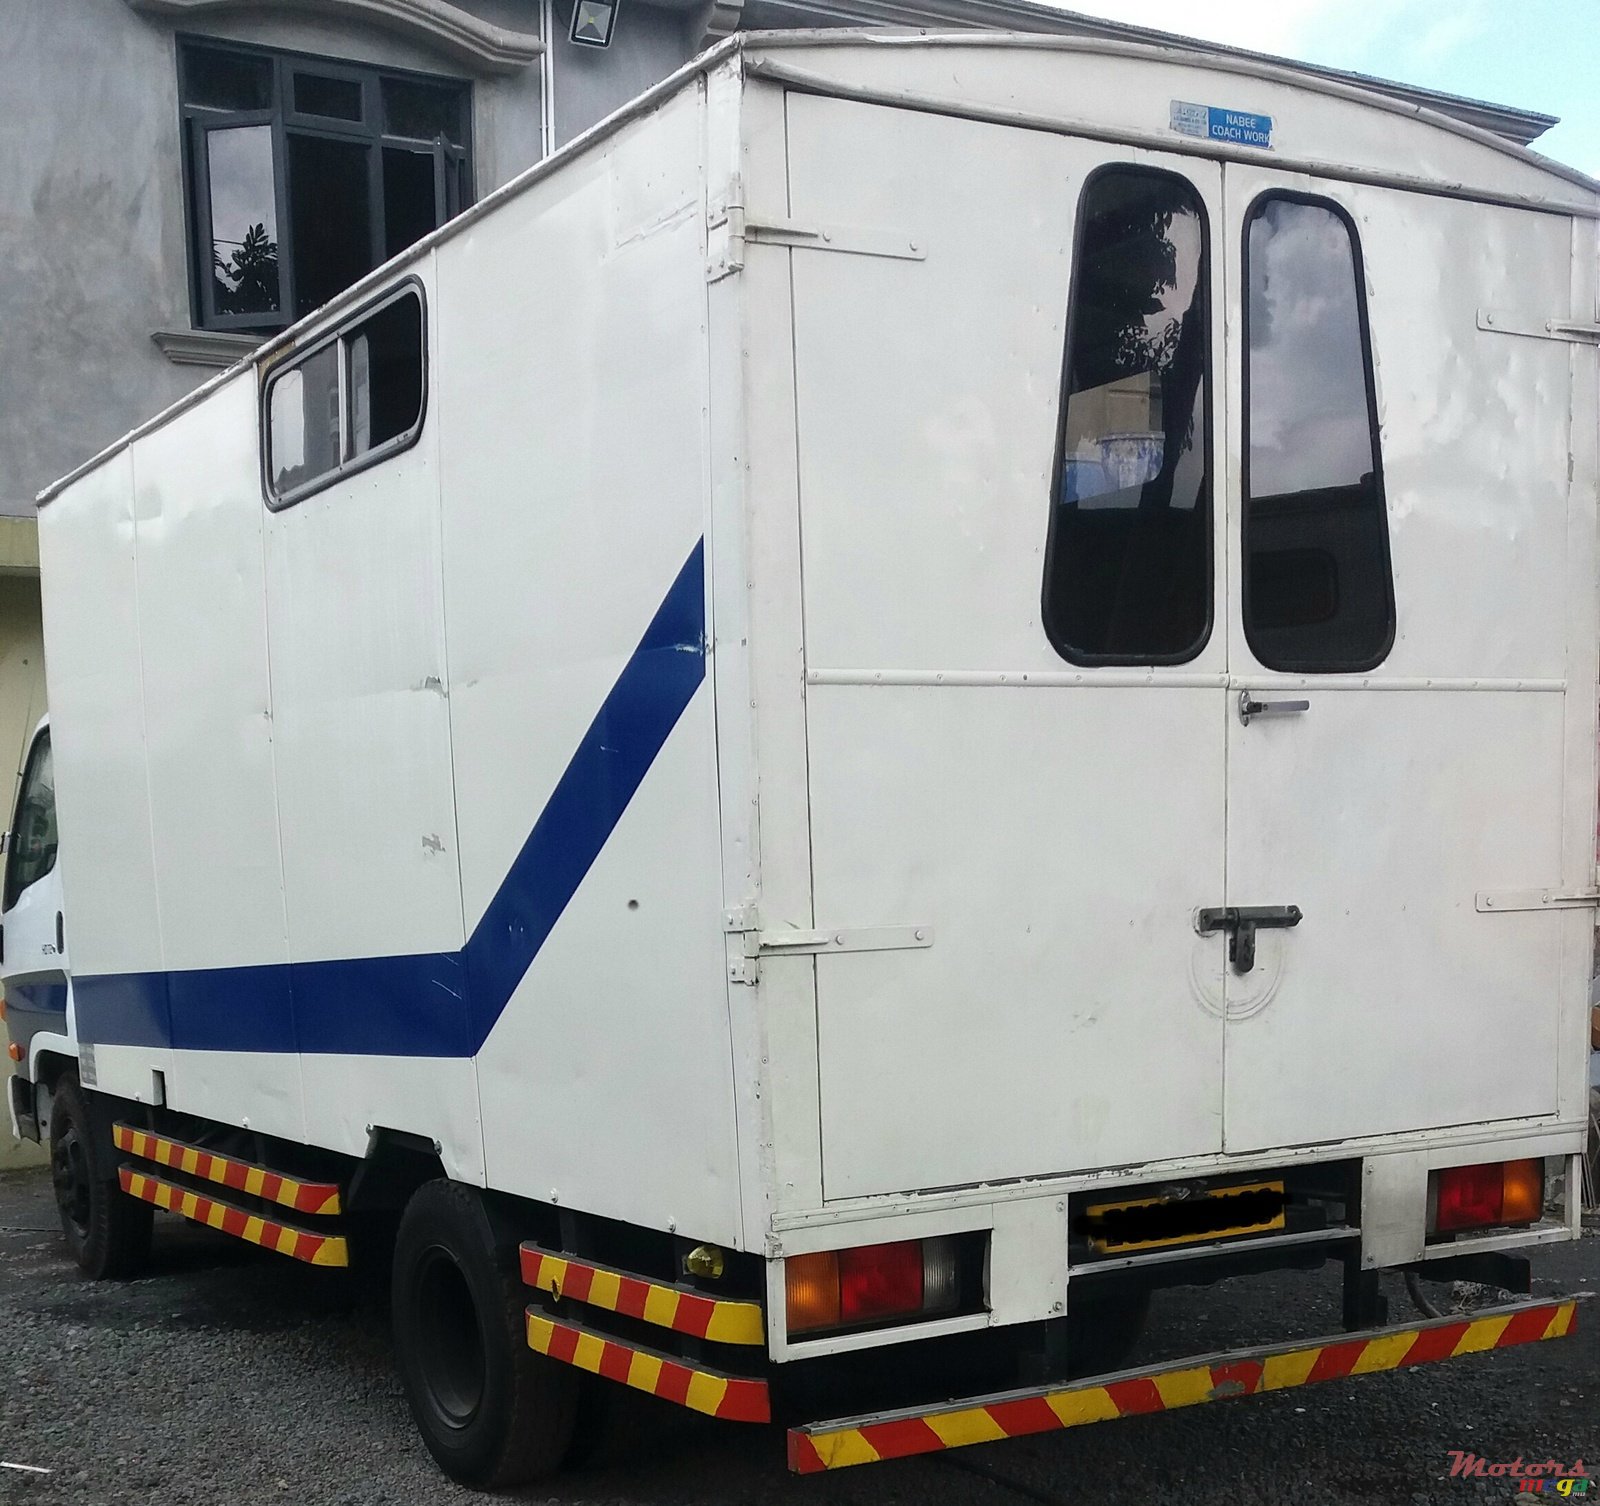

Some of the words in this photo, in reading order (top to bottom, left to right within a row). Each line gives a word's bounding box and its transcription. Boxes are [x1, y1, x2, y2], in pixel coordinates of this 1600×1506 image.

[1226, 113, 1256, 129] NABEE
[1212, 124, 1241, 139] COACH
[1244, 131, 1270, 143] WORK
